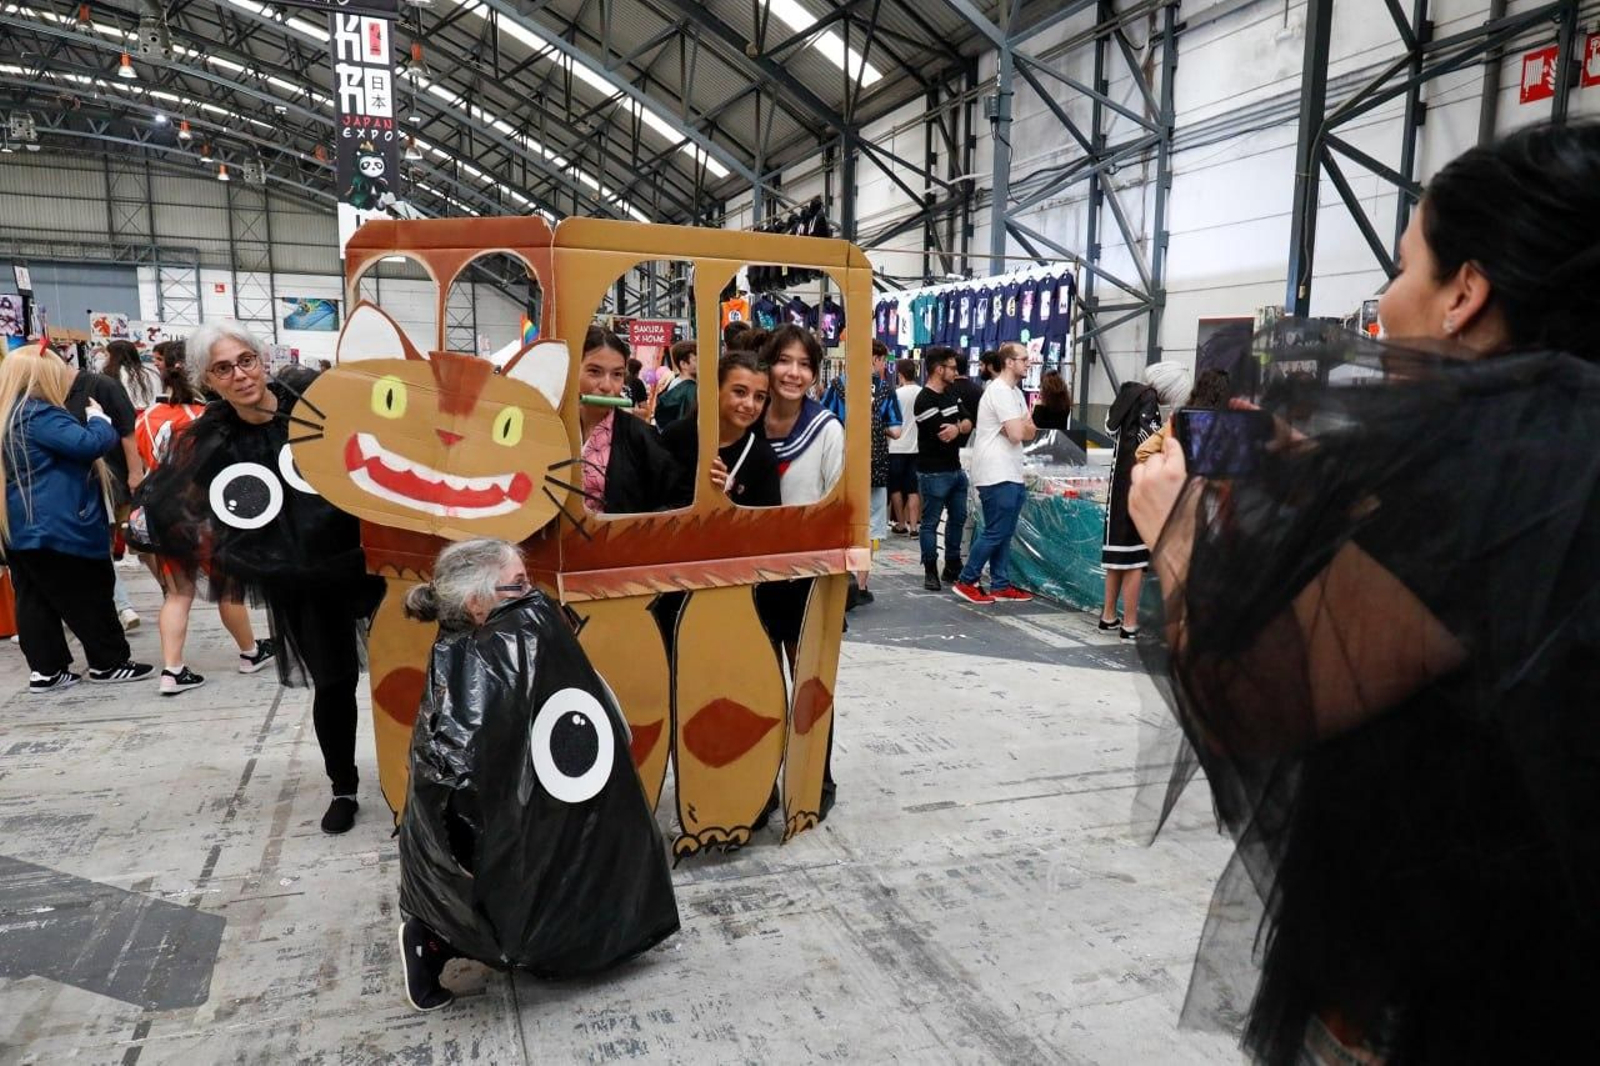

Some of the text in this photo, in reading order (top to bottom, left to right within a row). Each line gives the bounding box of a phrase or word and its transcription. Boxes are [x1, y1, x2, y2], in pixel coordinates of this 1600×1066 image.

[371, 75, 386, 109] 日本
[342, 115, 392, 130] JAPAN
[342, 127, 393, 141] EXPO
[634, 325, 664, 333] SAKURA
